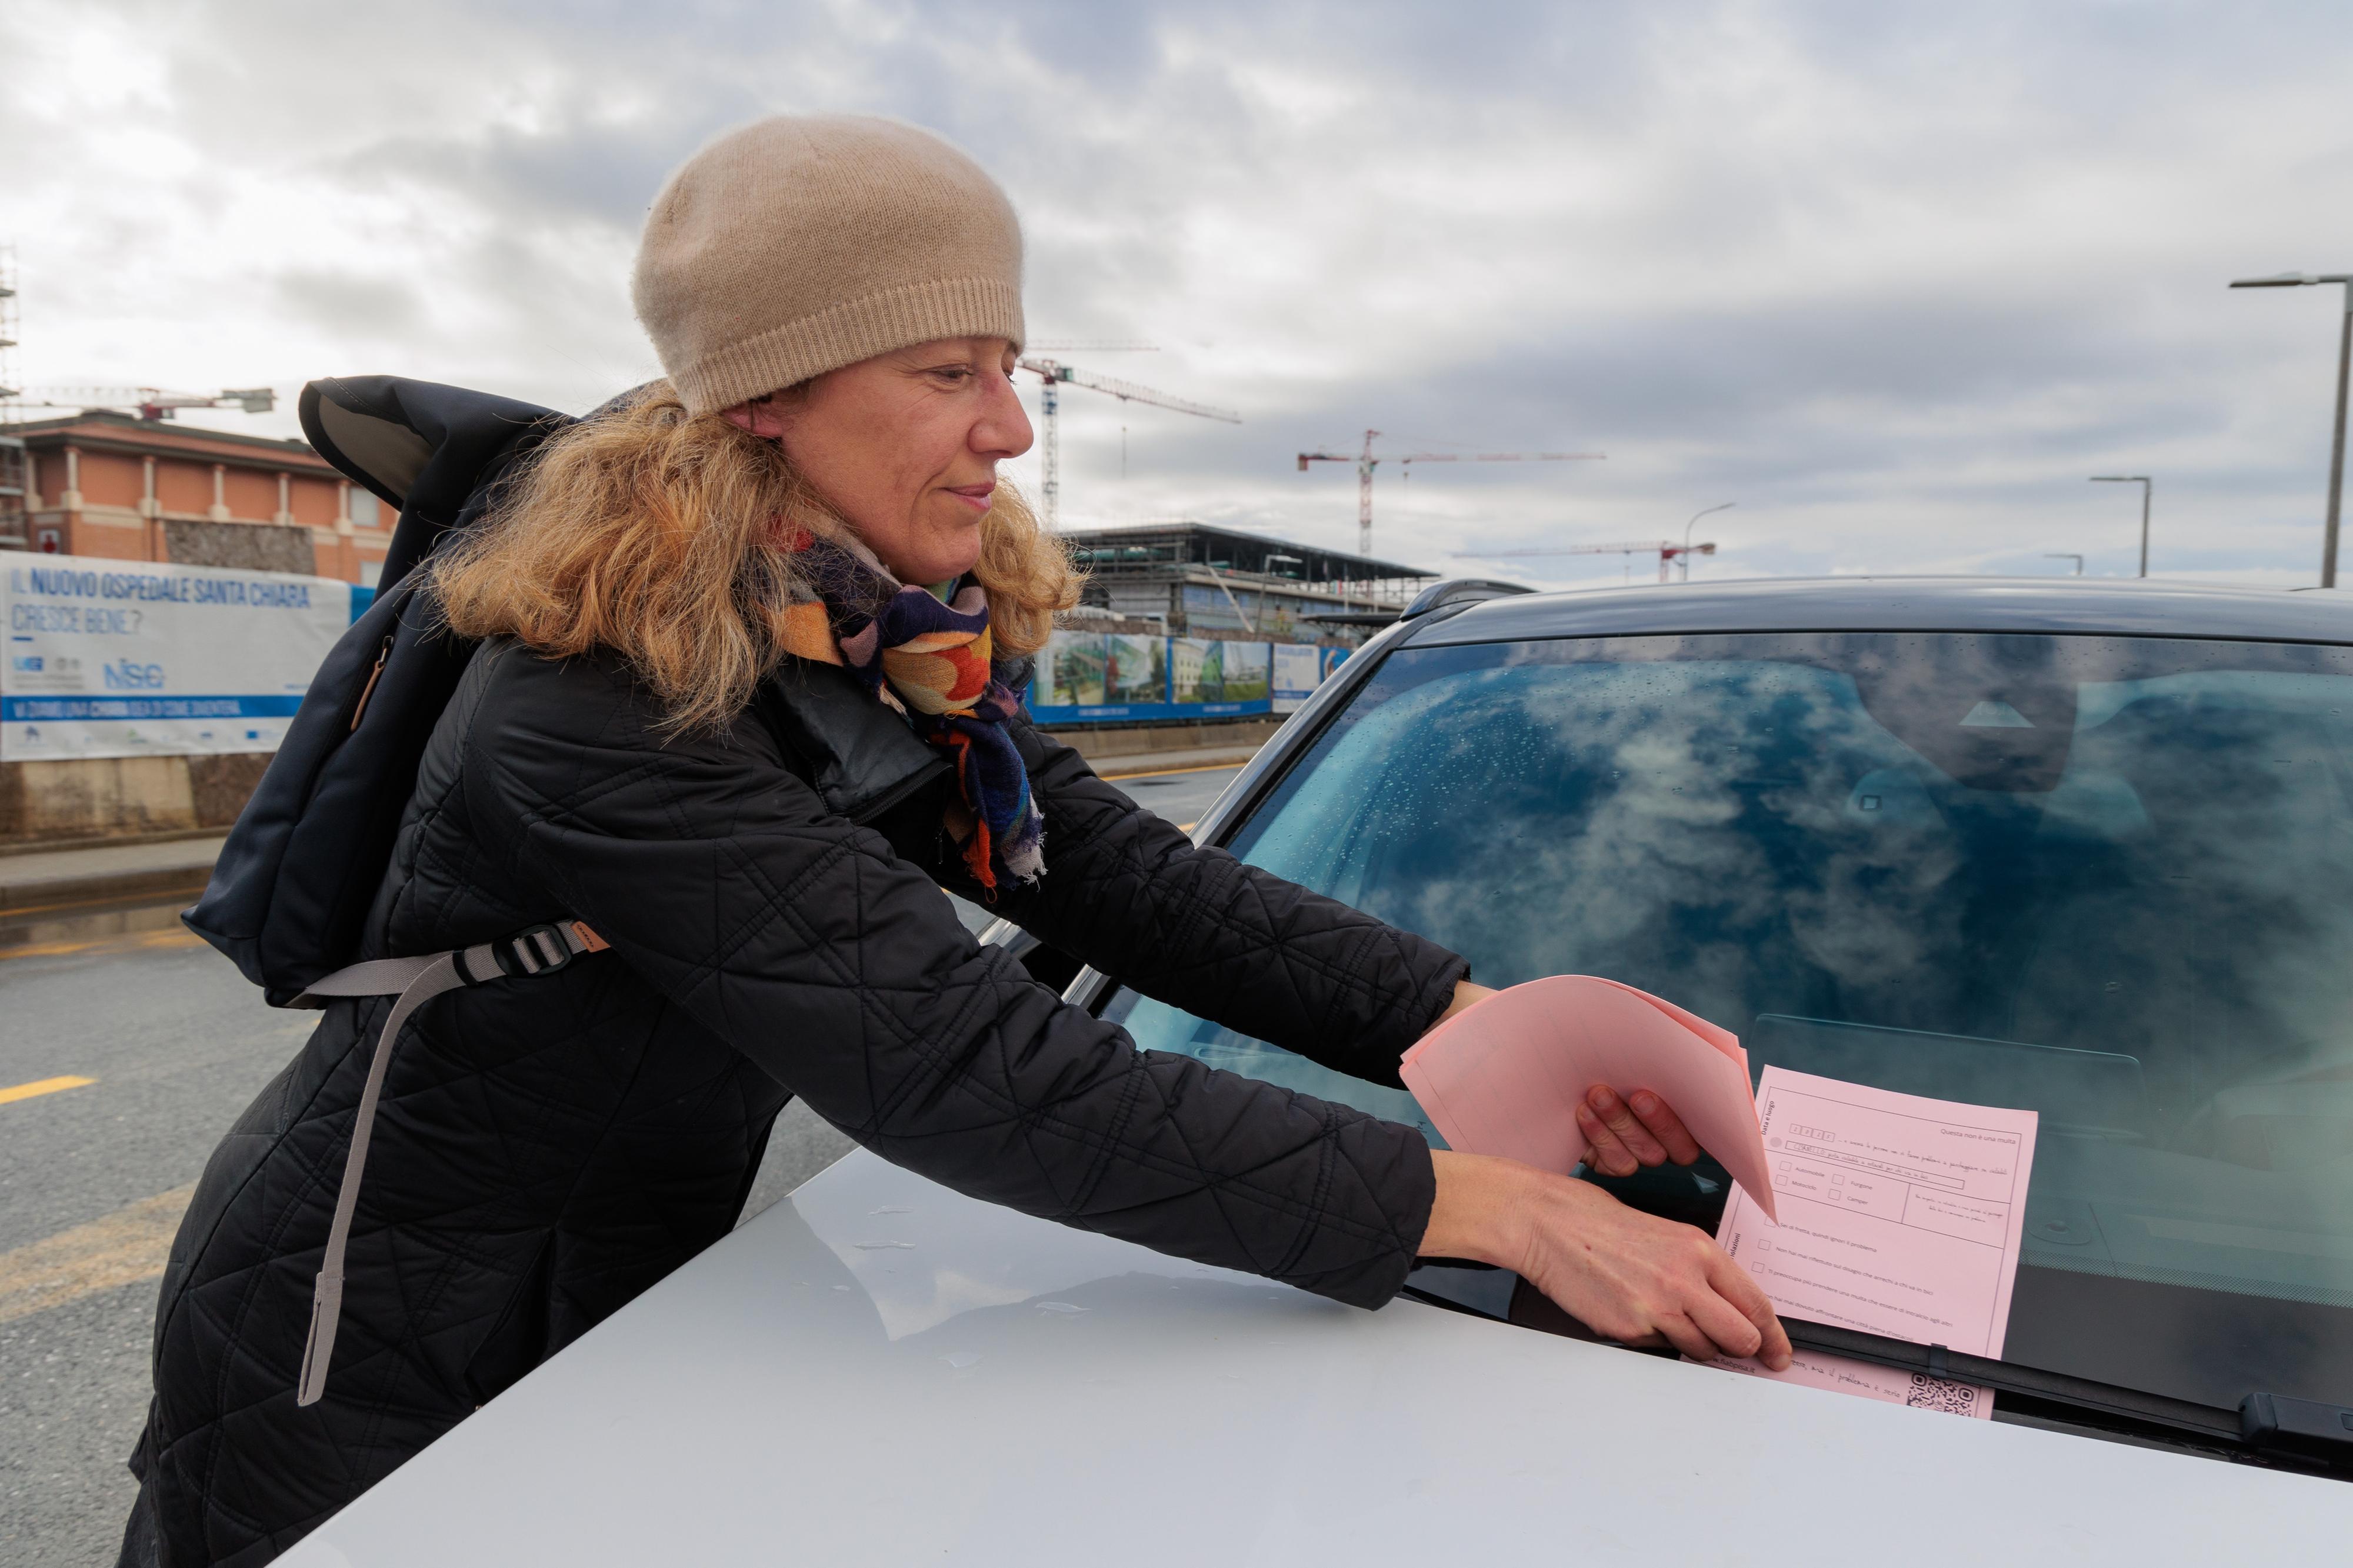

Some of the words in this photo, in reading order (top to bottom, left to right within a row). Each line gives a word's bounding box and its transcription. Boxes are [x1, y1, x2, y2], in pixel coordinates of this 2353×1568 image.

[31, 568, 96, 598] NUOVO
[102, 572, 189, 603] OSPEDALE
[194, 578, 246, 606] SANTA
[251, 582, 311, 609] CHIARA
[12, 603, 81, 633] CRESCE
[1761, 1120, 1769, 1136] Data
[1766, 1100, 1775, 1117] luogo
[1941, 1128, 1962, 1137] Questa
[1792, 1180, 1817, 1191] Motociclo
[1795, 1167, 1825, 1177] Automobile
[1851, 1180, 1873, 1190] Furgone
[1847, 1196, 1868, 1205] Camper
[1795, 1226, 1811, 1235] fretta,
[1812, 1230, 1829, 1240] quindi
[1830, 1236, 1845, 1245] ignori
[1851, 1241, 1877, 1253] problema
[1809, 1256, 1832, 1266] riflettuto
[1842, 1266, 1862, 1275] disagio
[1874, 1275, 1893, 1284] arrechi
[1774, 1270, 1802, 1283] preoccupa
[1812, 1282, 1838, 1293] prendere
[1879, 1302, 1898, 1310] essere
[1905, 1309, 1929, 1320] intralcio
[1795, 1302, 1814, 1311] dovuto
[1815, 1308, 1843, 1320] affrontare
[1869, 1325, 1885, 1333] piena
